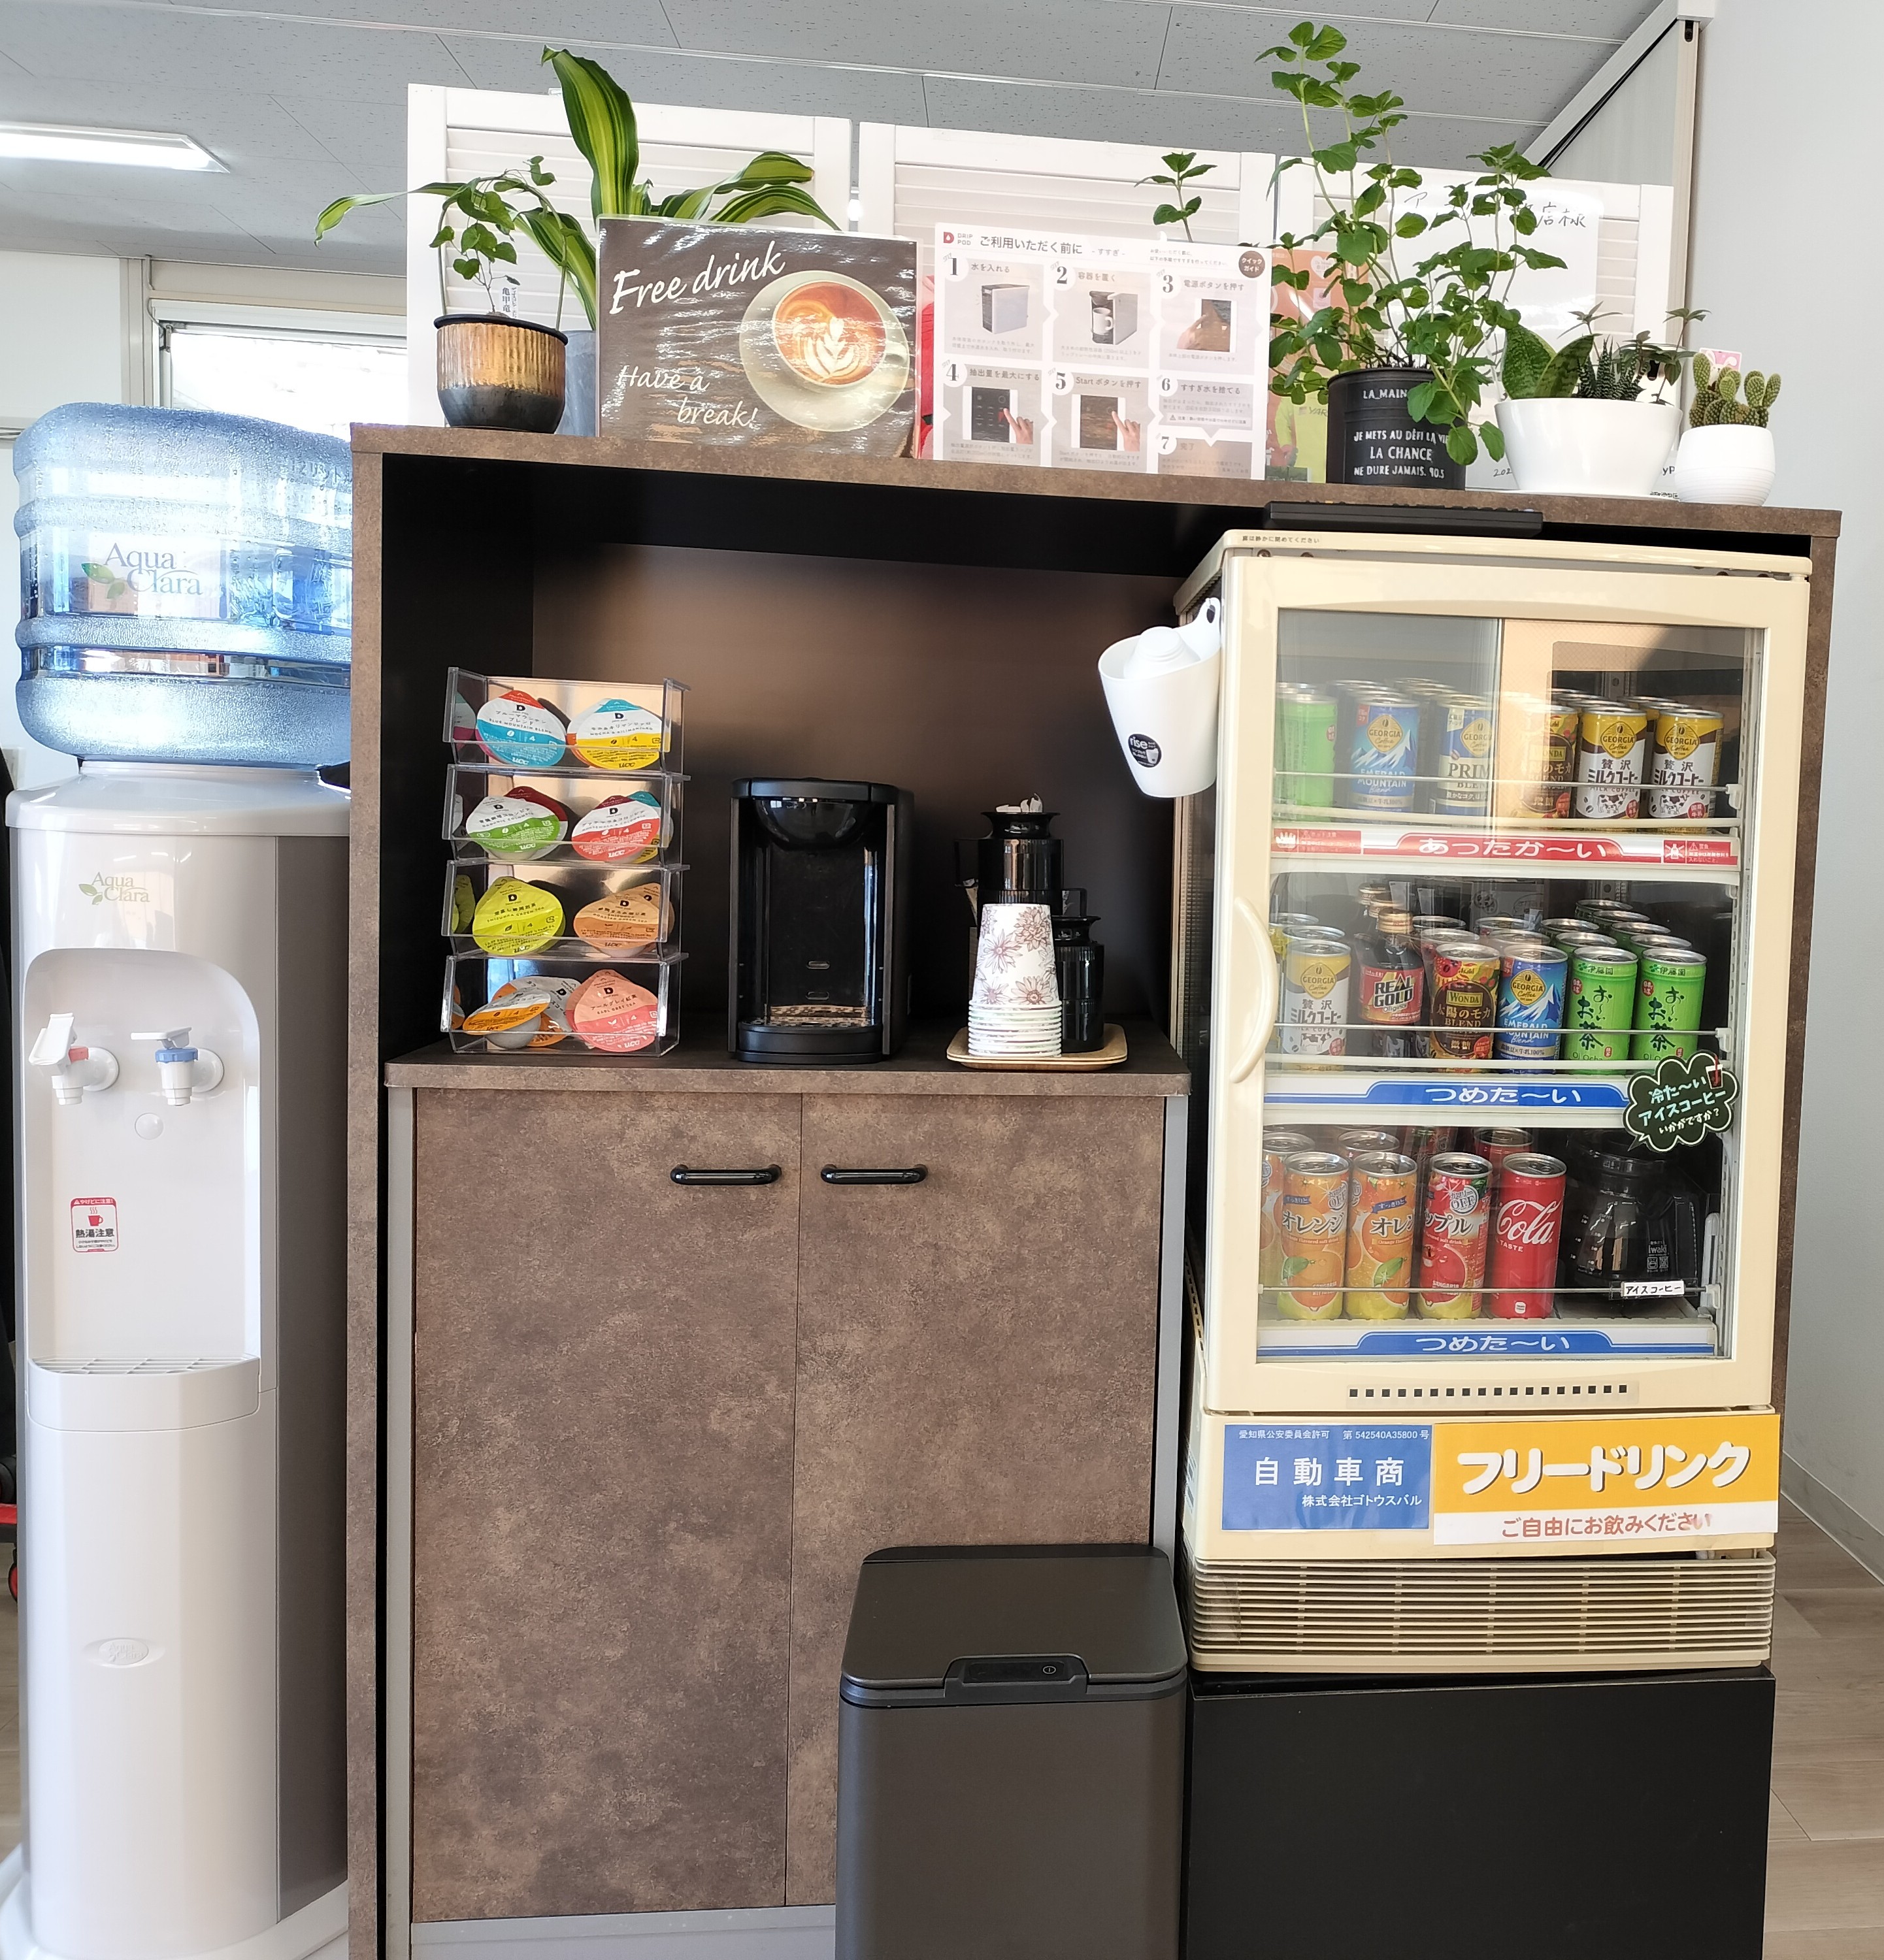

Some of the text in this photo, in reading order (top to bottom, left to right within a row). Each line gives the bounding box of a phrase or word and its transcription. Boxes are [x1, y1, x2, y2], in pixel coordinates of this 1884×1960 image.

[980, 236, 1082, 254] ご利用いただく前に
[950, 258, 958, 276] 1
[971, 263, 1010, 272] 水を入れる
[609, 240, 786, 315] Free drink
[1057, 267, 1067, 284] 2
[1078, 271, 1116, 282] 容器を置く
[1163, 275, 1174, 293] 3
[1184, 279, 1244, 291] 電源ボタンを押す
[618, 365, 710, 391] Have a
[946, 363, 959, 382] 4
[969, 368, 1040, 381] 抽出量を最大にする
[1055, 372, 1066, 389] 5
[1096, 378, 1141, 388] ボタンを押す
[1162, 378, 1170, 391] 6
[1181, 384, 1240, 394] すすぎ水を捨てる
[678, 397, 761, 431] break!
[1161, 436, 1169, 449] 7
[1354, 431, 1363, 441] JE
[1366, 430, 1387, 440] METS
[1389, 431, 1402, 440] AU
[1427, 433, 1437, 444] LA
[1180, 442, 1195, 451] 完了
[1370, 446, 1432, 461] LA CHANCE
[1354, 466, 1364, 476] NE
[1366, 465, 1389, 475] DURE
[105, 542, 175, 575] Aqua
[127, 568, 203, 595] Clara
[1369, 729, 1400, 738] GEORGIA
[1666, 736, 1697, 745] GEORGIA
[1130, 736, 1148, 749] rise
[1602, 759, 1630, 770] 贅沢
[1664, 759, 1693, 772] 贅沢
[1358, 778, 1406, 788] MOUNTAIN
[1588, 768, 1638, 783] ミルクコーヒー
[1654, 769, 1704, 785] ミルクコーヒー
[1419, 838, 1606, 858] あったか〜い
[91, 872, 134, 889] Aqua
[104, 887, 150, 903] Clara
[1588, 966, 1613, 975] 伊藤園
[1660, 967, 1685, 976] 伊藤園
[1375, 974, 1413, 994] REAL
[1512, 982, 1544, 992] GEORGIA
[1302, 999, 1332, 1009] 贅沢
[1374, 988, 1413, 1007] GOLD
[1291, 1008, 1342, 1024] ミルクコーヒー
[1436, 1004, 1491, 1019] 太陽のモカ
[1445, 1018, 1481, 1027] BLEND
[1504, 1018, 1547, 1029] EMERALD
[1577, 996, 1604, 1051] お茶
[1648, 997, 1676, 1051] お茶
[1425, 1087, 1581, 1103] つめた〜い
[1649, 1077, 1707, 1104] 冷た〜い
[1638, 1090, 1726, 1126] アイスコーヒー
[1659, 1108, 1719, 1134] いかがですか？
[1378, 1200, 1404, 1209] すっきりと
[1451, 1196, 1475, 1209] OFF
[1283, 1211, 1344, 1233] オレンジ
[1496, 1199, 1561, 1245] Cola
[76, 1228, 114, 1238] 熱湯注意
[1500, 1241, 1524, 1252] TASTE
[1626, 1285, 1681, 1295] アイスコーヒー
[1415, 1335, 1570, 1352] つめた〜い
[1239, 1429, 1429, 1440] 愛知県公安委員会許可 第 542540A35800 号
[1255, 1456, 1404, 1486] 自動車商
[1457, 1441, 1751, 1495] フリードリンク
[1302, 1494, 1423, 1507] 株式会社ゴトウスバル
[1501, 1512, 1713, 1538] ご自由にお飲みください
